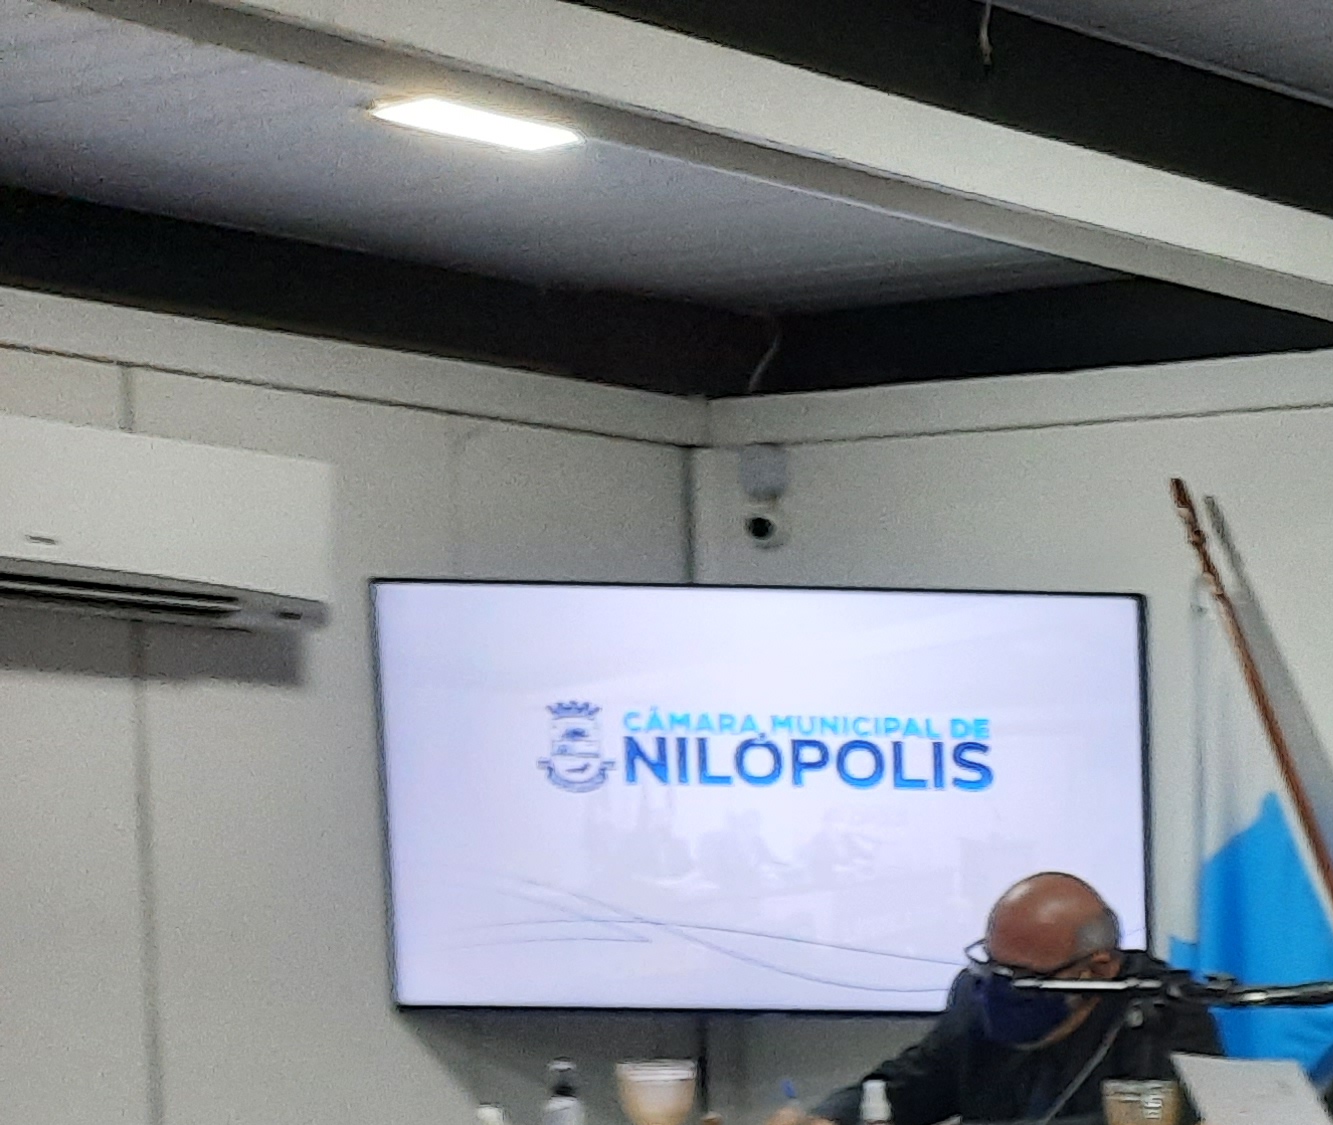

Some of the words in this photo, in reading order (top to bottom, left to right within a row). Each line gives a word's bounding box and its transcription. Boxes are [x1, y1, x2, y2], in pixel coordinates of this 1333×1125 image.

[622, 706, 759, 734] CÂMARA
[771, 714, 940, 738] MUNICIPAL
[949, 718, 991, 739] DE
[623, 733, 994, 792] NILÓPOLIS
